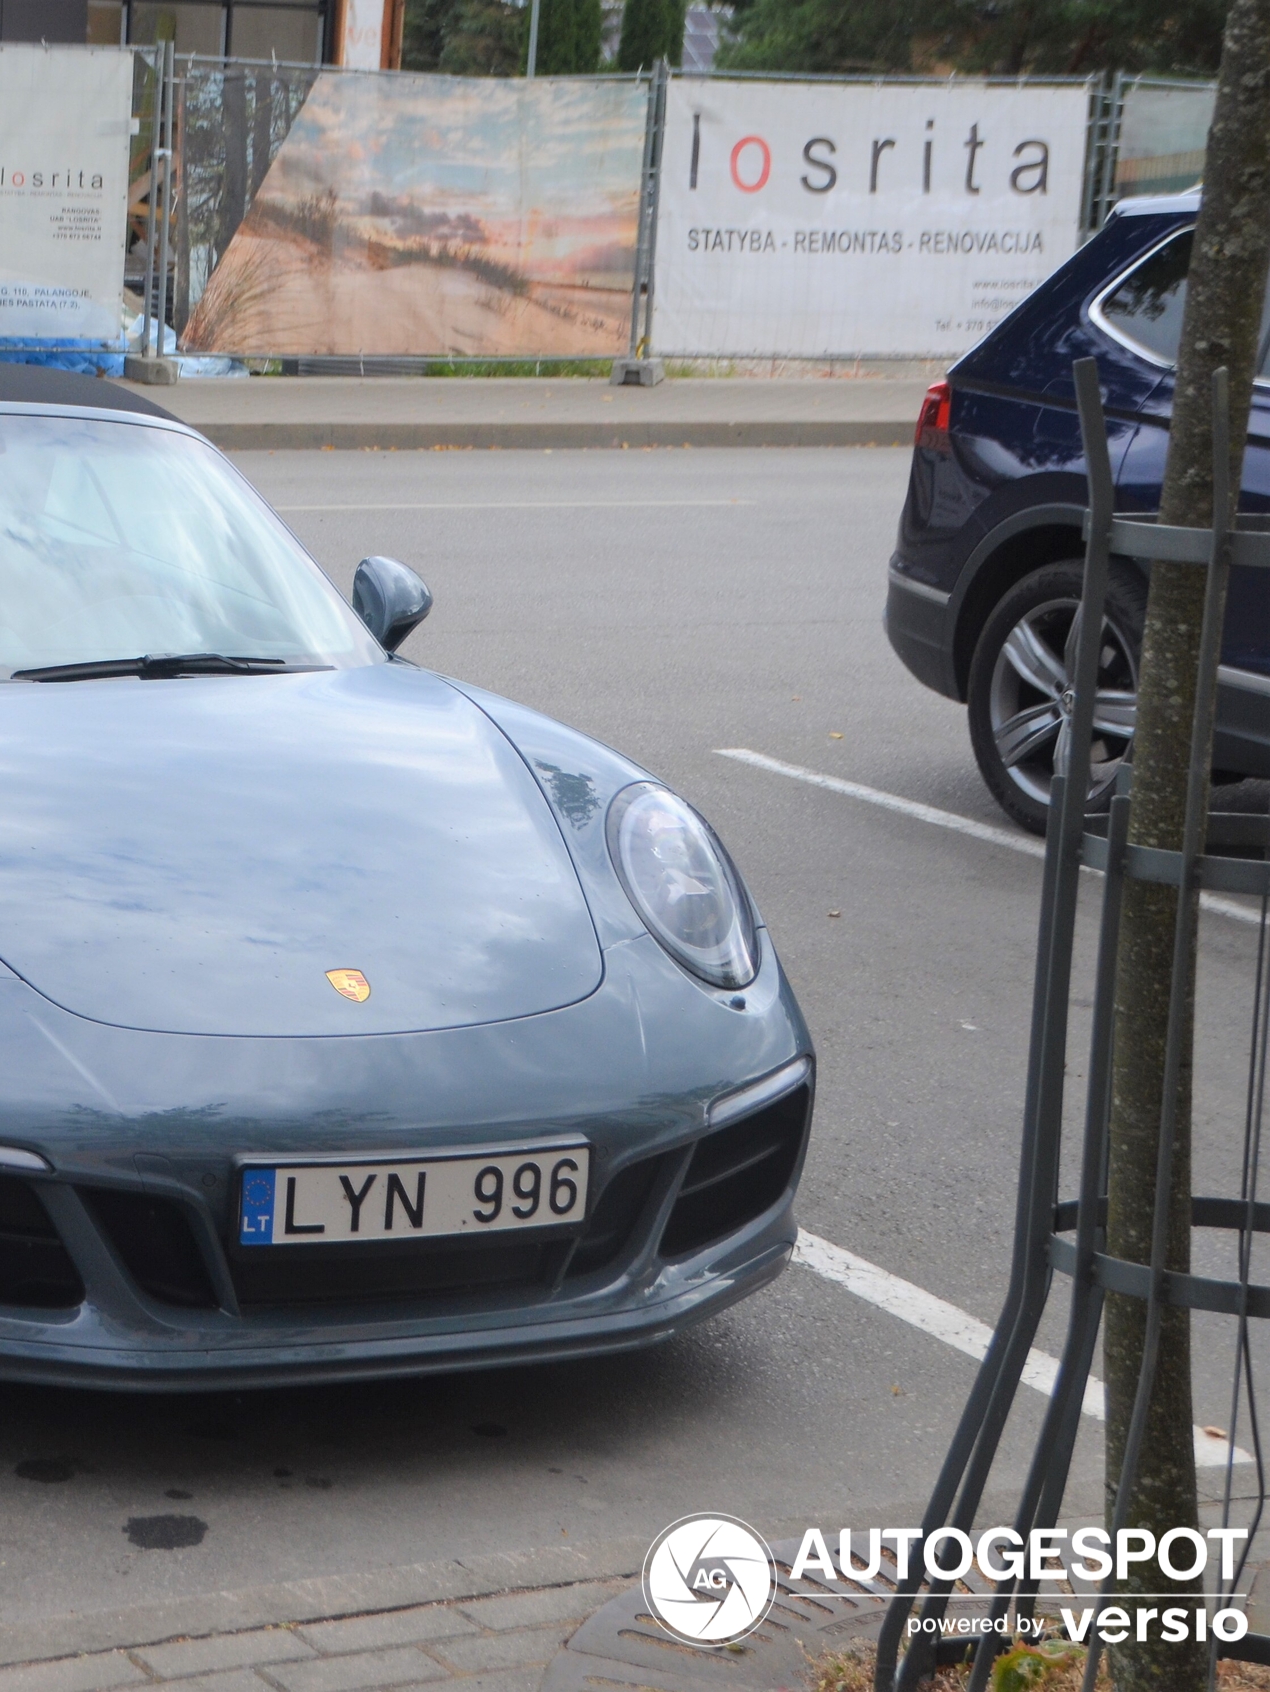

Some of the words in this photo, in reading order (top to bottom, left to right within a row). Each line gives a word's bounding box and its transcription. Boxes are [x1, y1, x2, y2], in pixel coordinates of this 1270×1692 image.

[689, 112, 1050, 196] losrita
[0, 167, 104, 190] losrita
[687, 228, 777, 253] STATYBA
[793, 230, 904, 254] REMONTAS
[919, 231, 1044, 255] RENOVACIJA
[34, 288, 92, 299] PALANGOJE,
[972, 278, 1044, 291] www.losrita.l
[16, 298, 57, 310] PASTATĄ
[964, 320, 983, 332] 370
[243, 1215, 270, 1233] LT
[285, 1171, 427, 1235] LYN
[473, 1157, 579, 1223] 996
